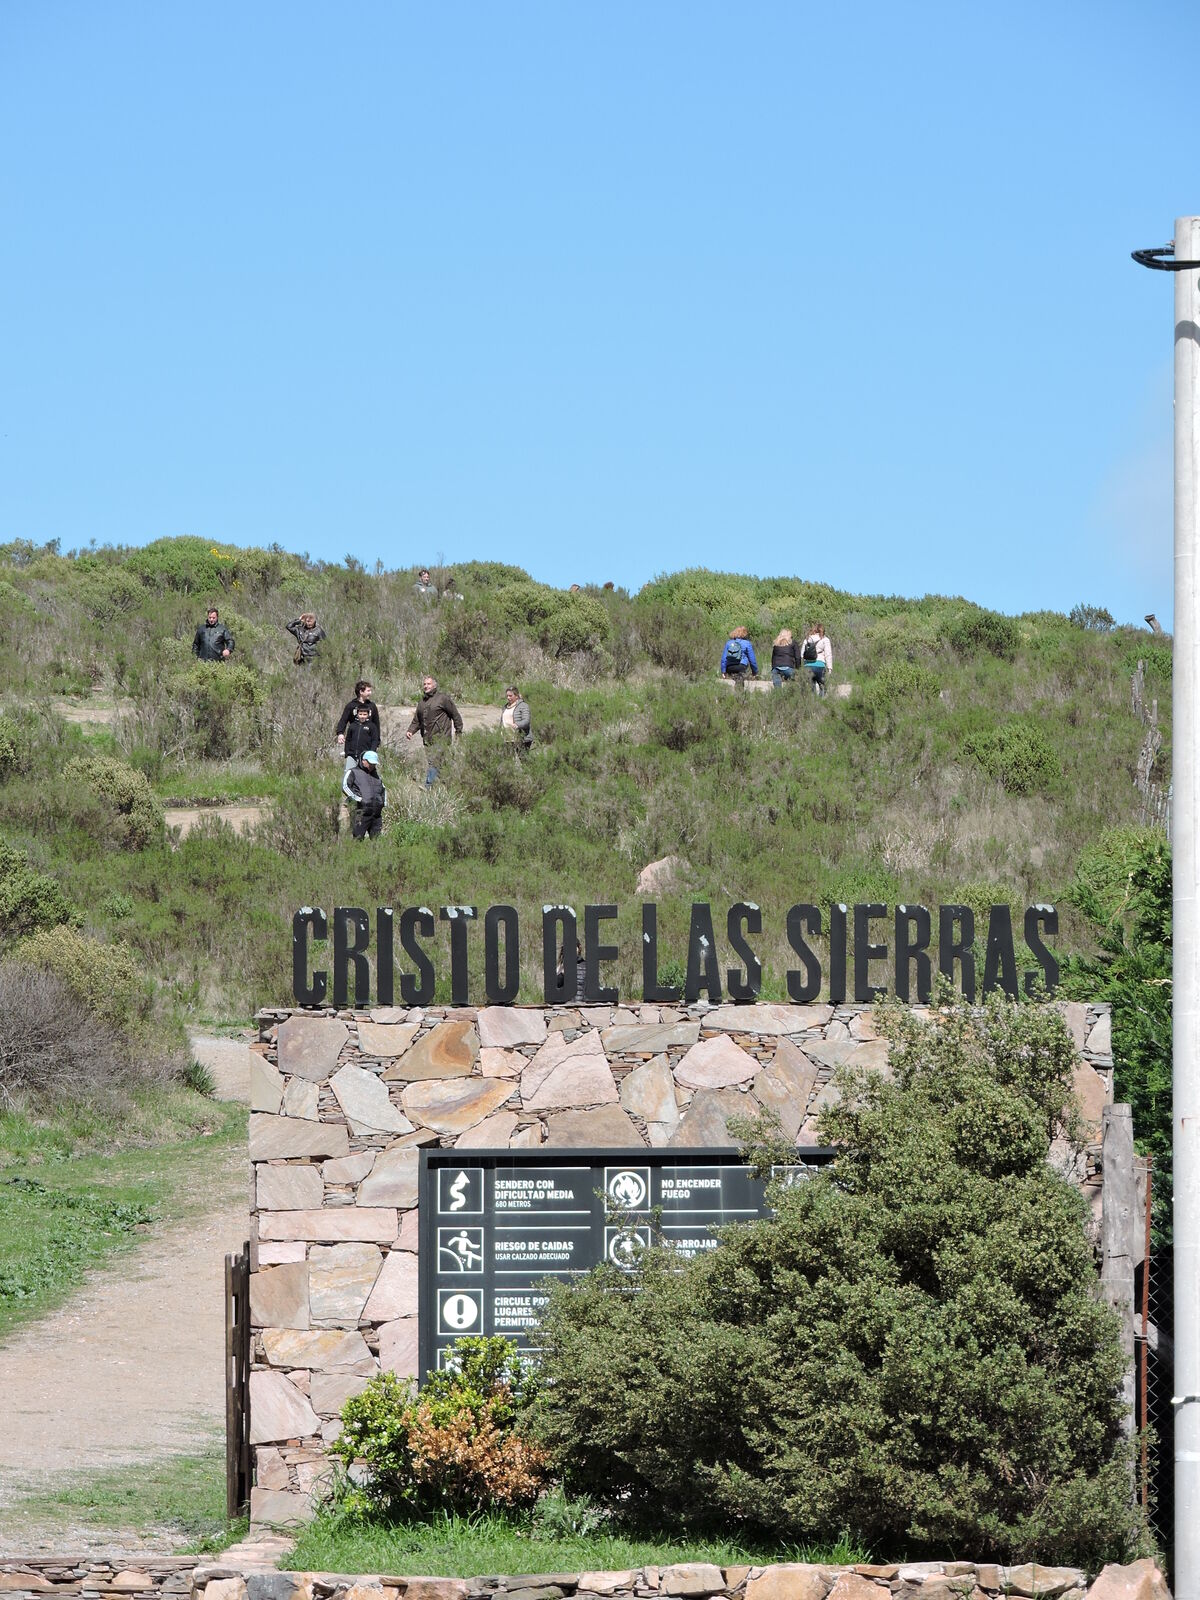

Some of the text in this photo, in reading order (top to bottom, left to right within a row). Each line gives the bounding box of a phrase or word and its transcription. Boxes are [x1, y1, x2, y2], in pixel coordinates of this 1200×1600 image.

[293, 903, 1059, 1007] CRISTO DE LAS SIERRAS
[494, 1180, 554, 1189] SENDERO CON
[661, 1179, 721, 1189] NO ENCENDER
[494, 1190, 574, 1199] DIFICULTAD MEDIA
[661, 1190, 690, 1198] FUEGO
[494, 1242, 574, 1251] RIESGO DE CAIDAS
[676, 1240, 718, 1248] ARROJAR
[494, 1297, 531, 1306] CIRCULE
